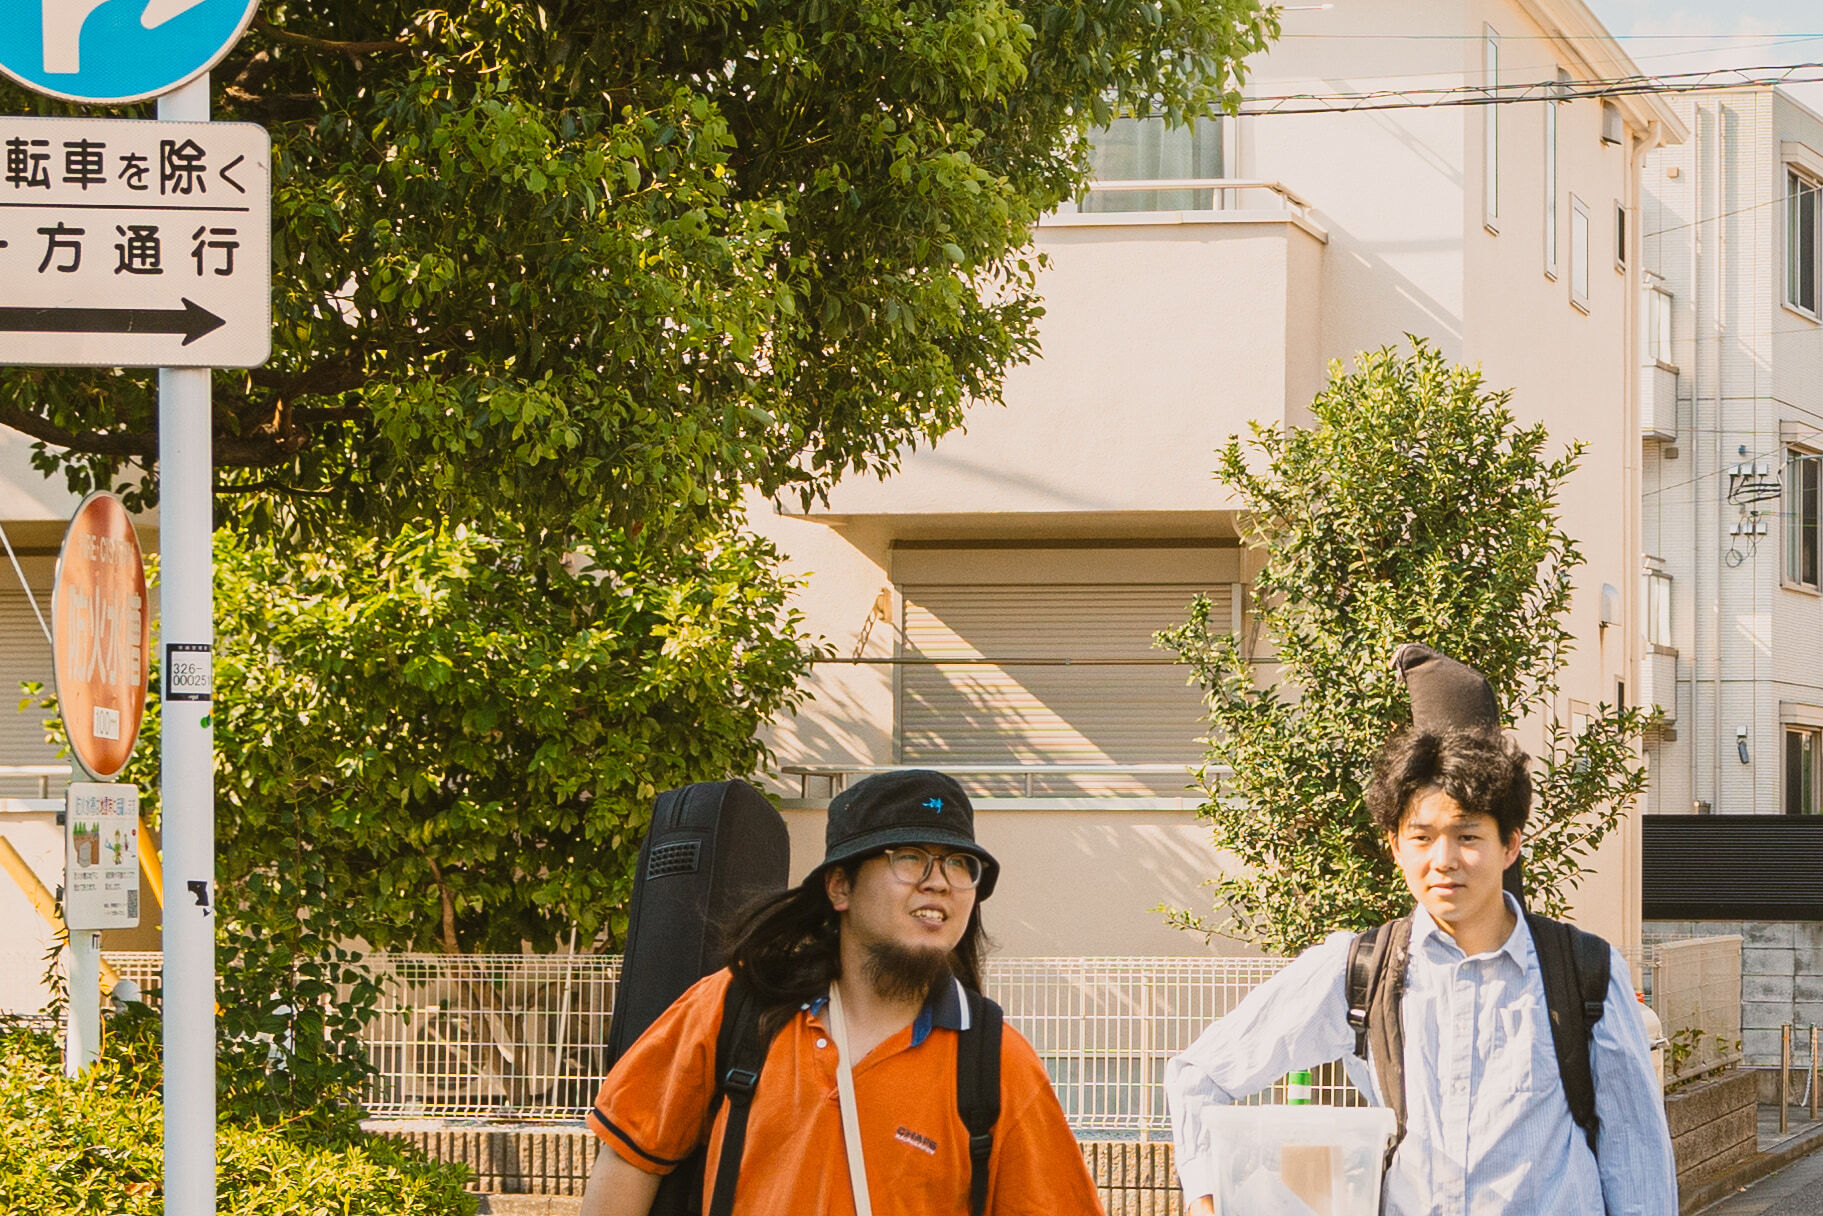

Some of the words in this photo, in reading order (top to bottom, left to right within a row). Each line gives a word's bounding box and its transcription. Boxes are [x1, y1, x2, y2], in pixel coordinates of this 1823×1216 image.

[5, 136, 246, 196] 転車を除く
[0, 222, 240, 277] 方通行
